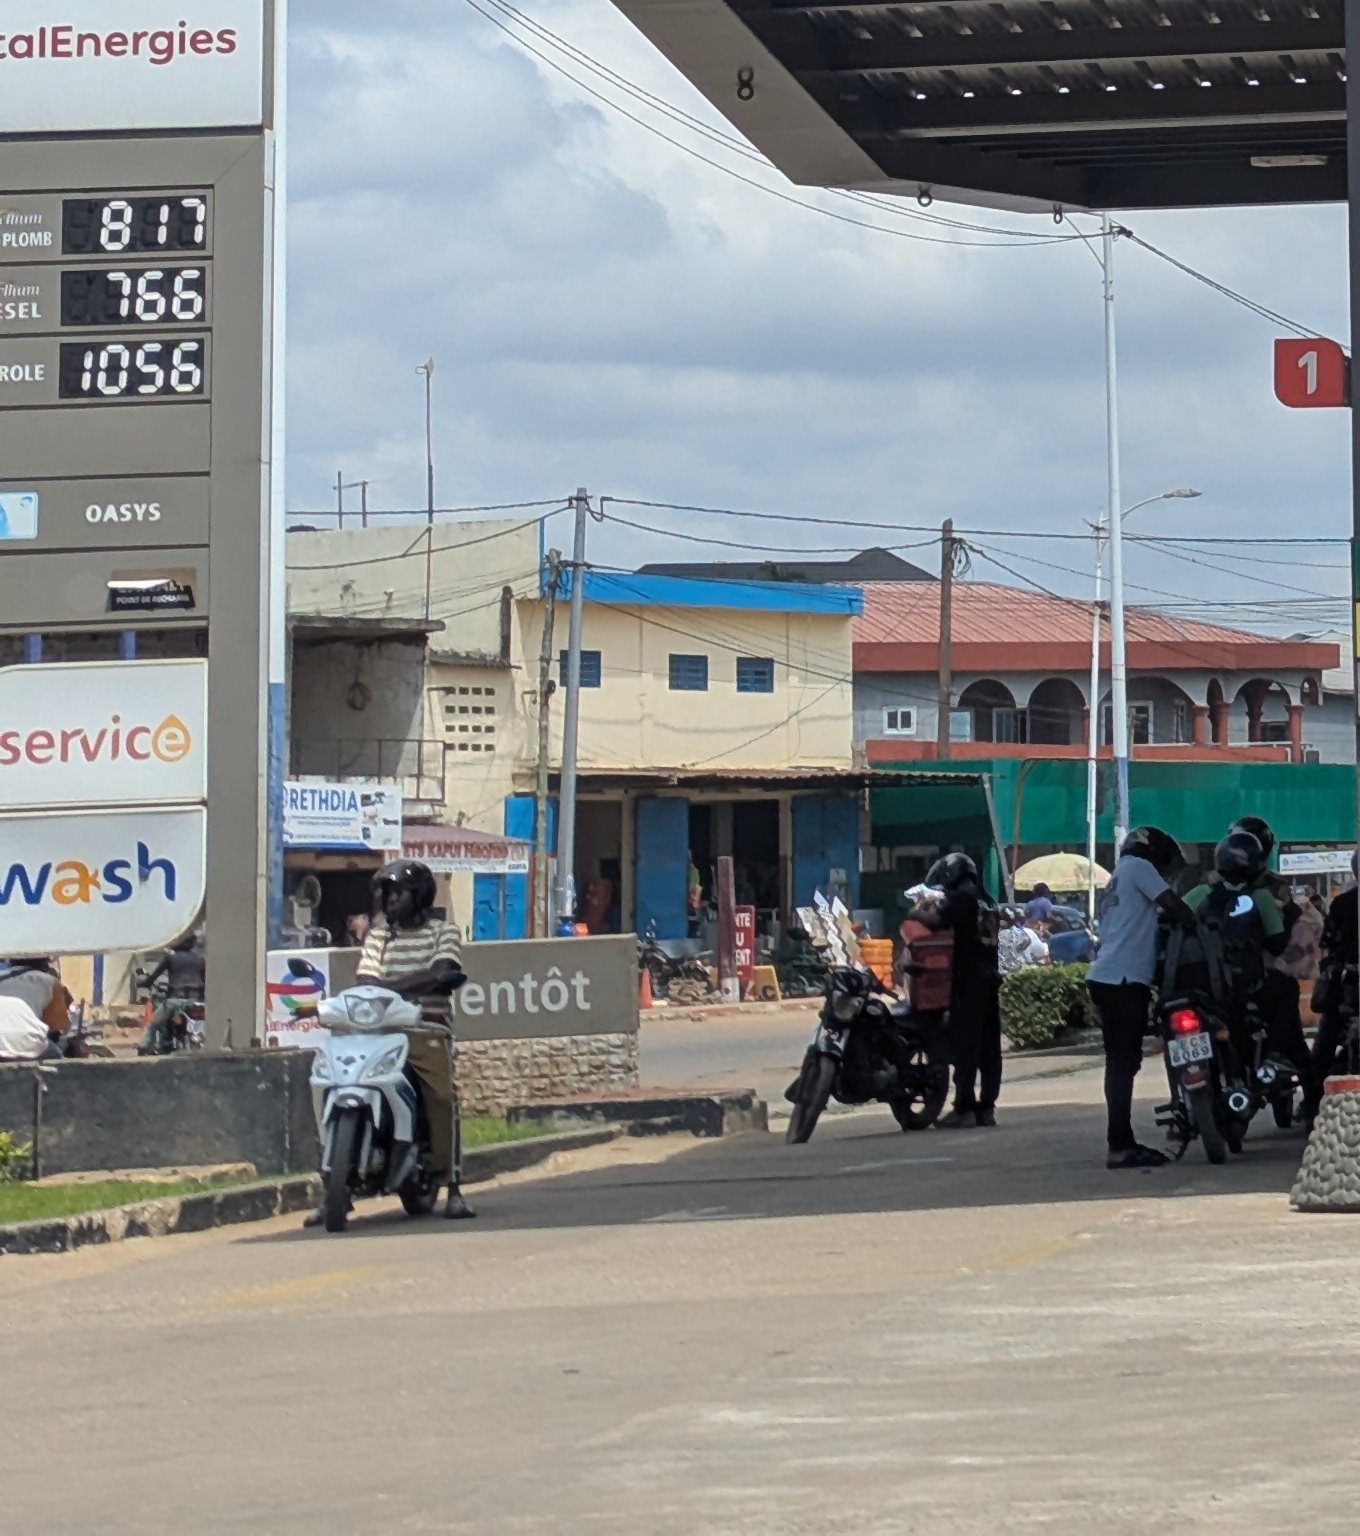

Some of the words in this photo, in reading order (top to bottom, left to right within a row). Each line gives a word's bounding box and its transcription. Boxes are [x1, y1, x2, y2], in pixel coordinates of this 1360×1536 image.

[2, 231, 52, 248] PLOMB
[100, 199, 205, 251] 817
[107, 269, 202, 321] 766
[81, 341, 201, 395] 1056
[1298, 350, 1318, 395] 1
[85, 502, 161, 523] OASYS
[0, 714, 191, 765] service
[0, 841, 177, 905] wash
